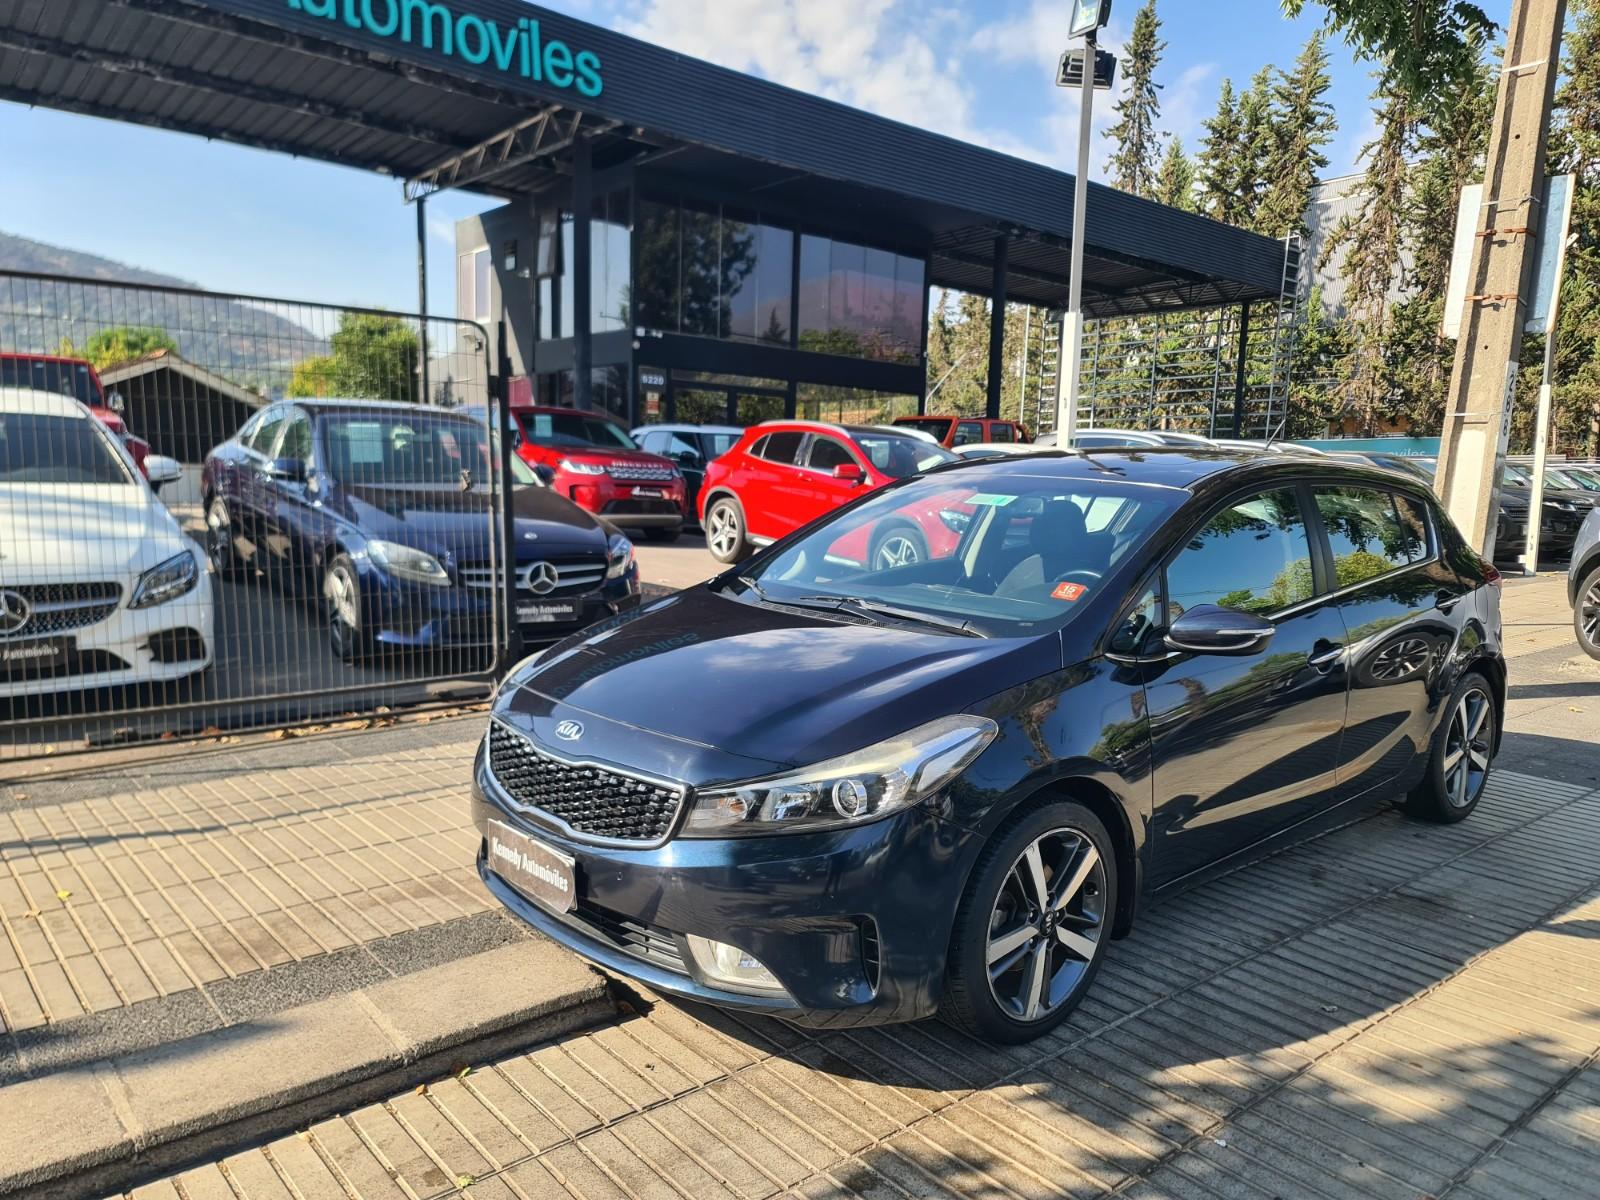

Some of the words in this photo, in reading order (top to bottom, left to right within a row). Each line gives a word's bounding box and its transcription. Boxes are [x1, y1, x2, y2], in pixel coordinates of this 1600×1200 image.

[287, 0, 604, 97] omoviles
[556, 722, 581, 739] KIA
[492, 836, 523, 871] Kennedy
[522, 852, 569, 893] Automóviles
